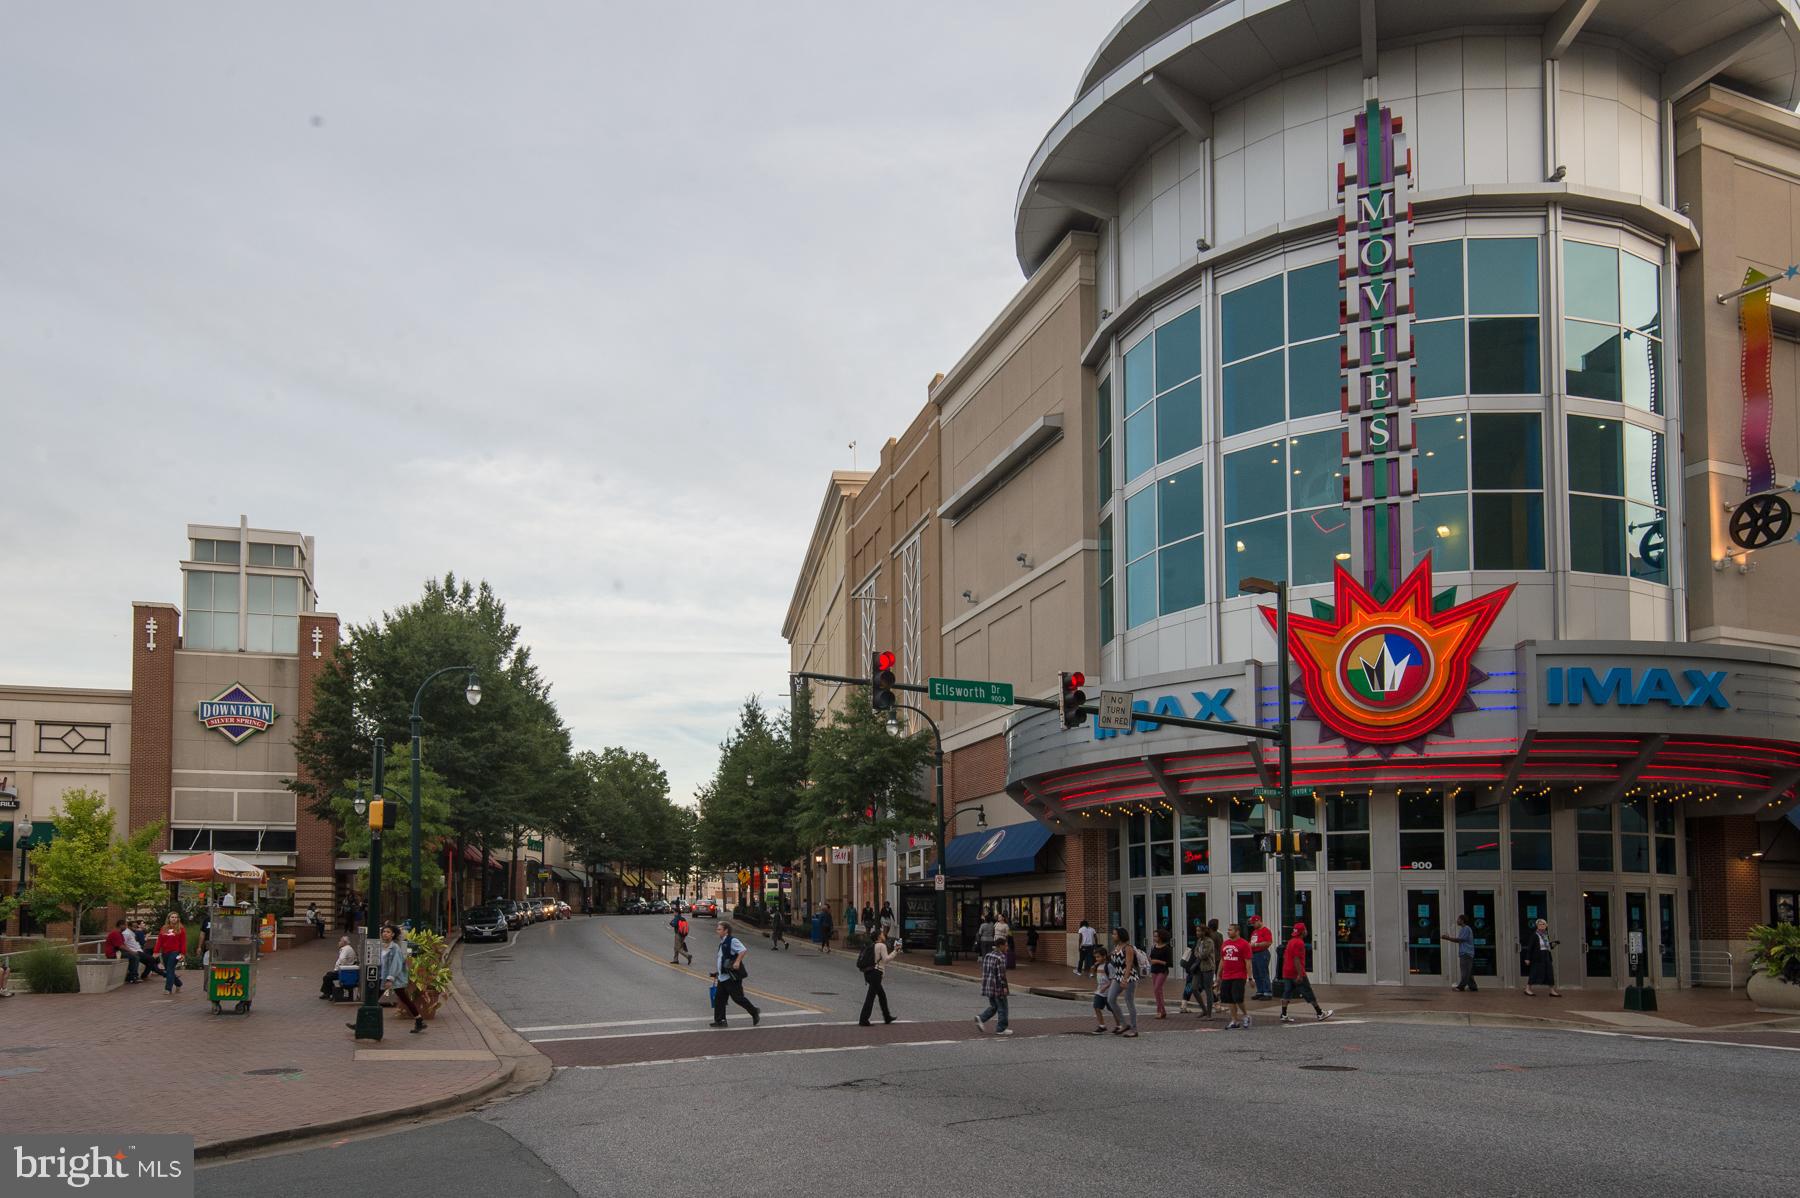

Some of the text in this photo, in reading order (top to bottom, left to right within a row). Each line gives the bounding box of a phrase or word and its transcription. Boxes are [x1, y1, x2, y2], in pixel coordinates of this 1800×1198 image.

[1358, 192, 1394, 446] MOVIES
[935, 683, 1001, 698] Ellsworth Dr
[1546, 667, 1731, 709] IMAX
[1110, 696, 1123, 704] NO
[203, 703, 270, 720] DOWNTOWN
[1106, 706, 1126, 714] TURN
[210, 717, 263, 727] SILVER SPRING
[1101, 716, 1129, 726] ON RED
[1411, 861, 1433, 869] 900
[214, 967, 241, 980] NUTS
[216, 984, 243, 997] NUTS
